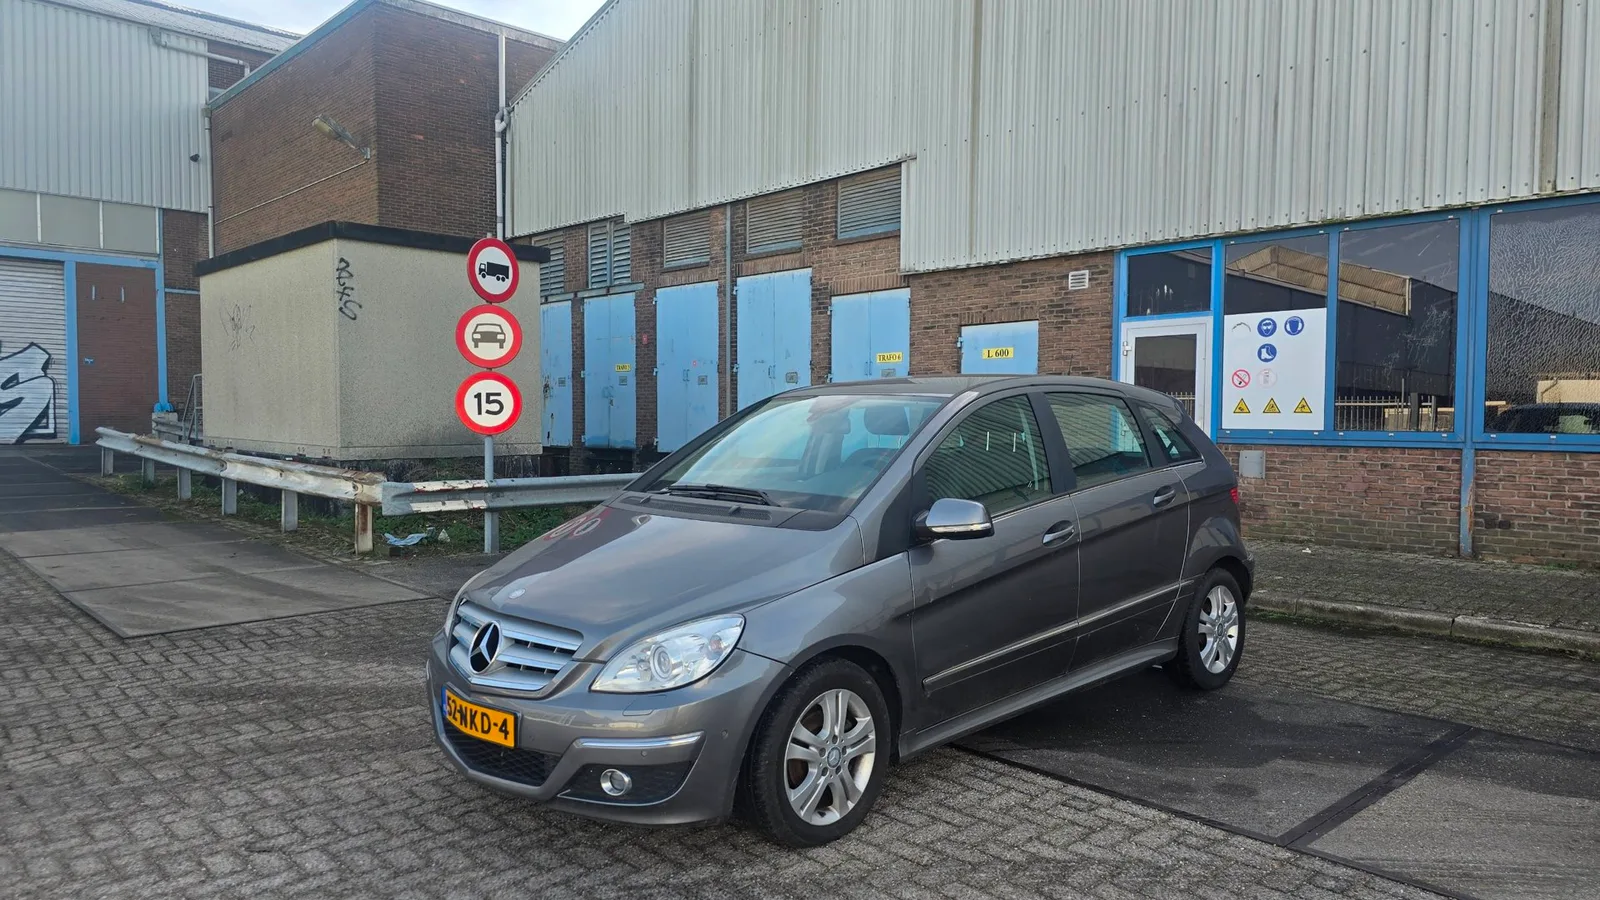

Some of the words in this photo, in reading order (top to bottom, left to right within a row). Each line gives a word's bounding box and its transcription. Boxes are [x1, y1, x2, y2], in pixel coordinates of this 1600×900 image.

[877, 353, 897, 362] TRAFO
[986, 349, 994, 358] L
[995, 348, 1010, 358] 600
[473, 392, 505, 416] 15
[446, 694, 510, 741] 52-NKD-4
